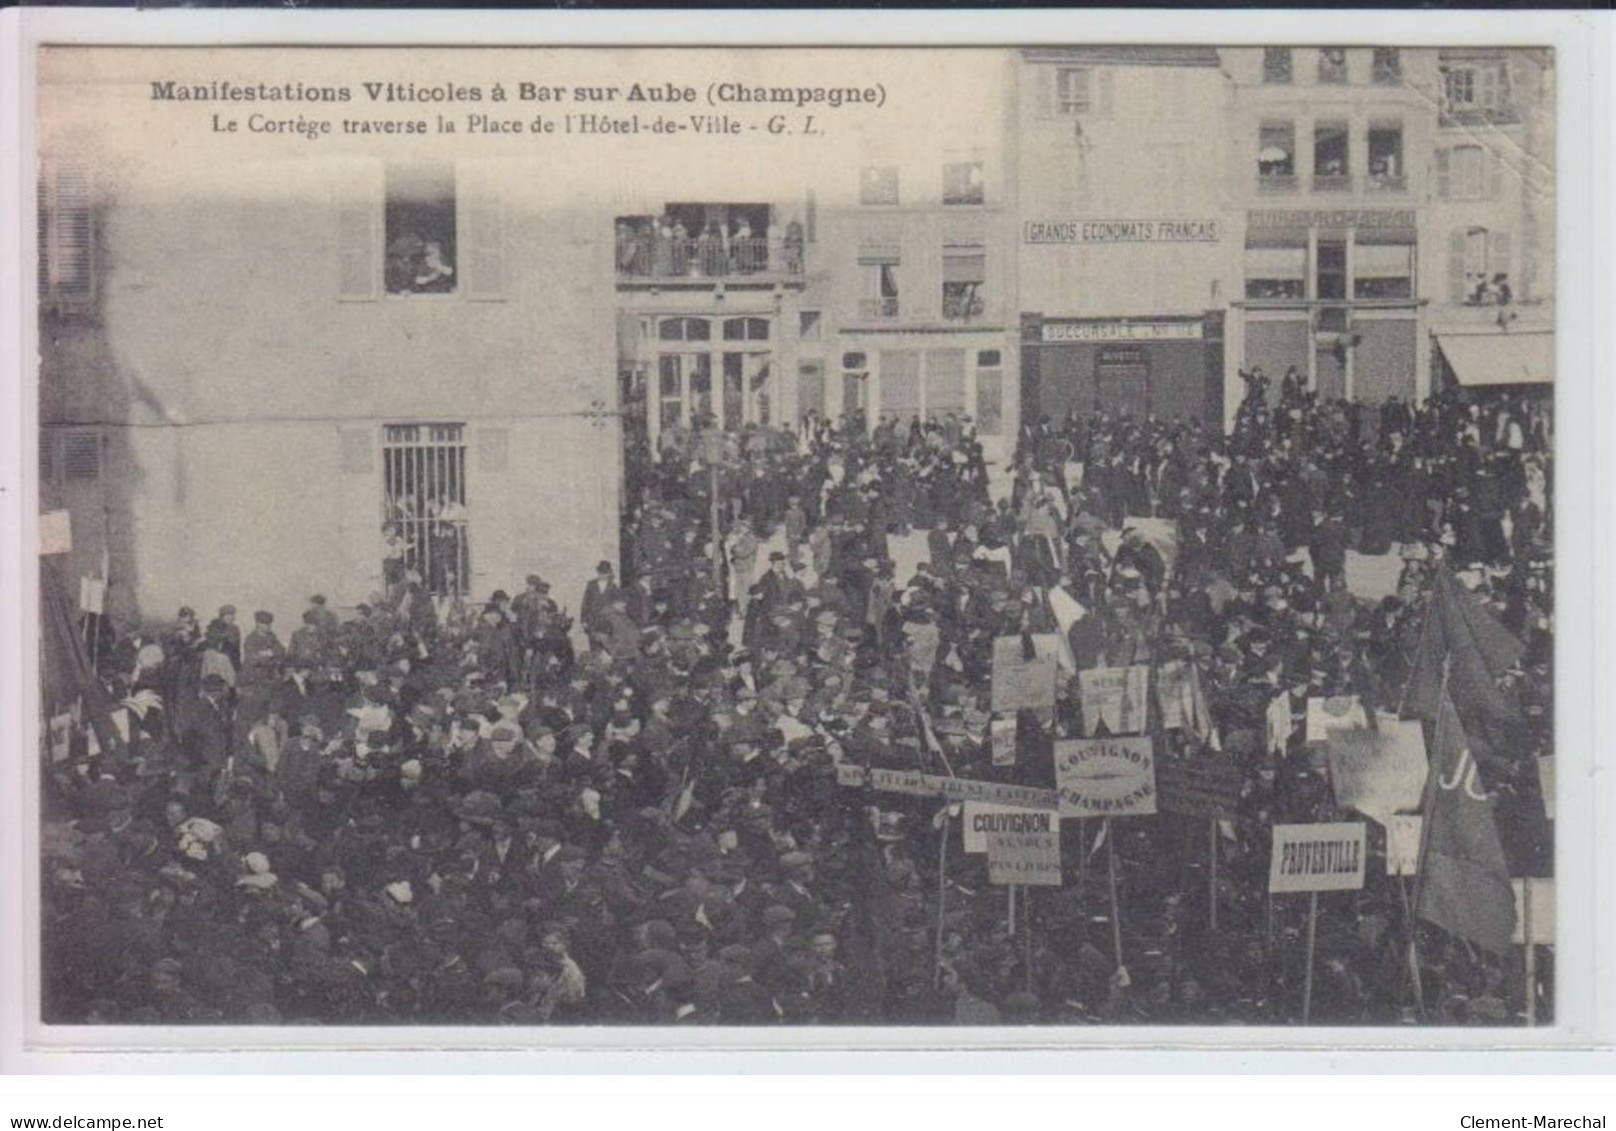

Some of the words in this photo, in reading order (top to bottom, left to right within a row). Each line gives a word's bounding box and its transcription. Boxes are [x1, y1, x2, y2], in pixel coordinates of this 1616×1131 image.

[1029, 222, 1078, 241] GRANDS
[1082, 221, 1154, 241] ECONOMATS
[1049, 323, 1136, 340] SUCCURSALE
[1058, 744, 1151, 773] COUVIGNON
[1059, 782, 1154, 811] CHAMPAGNE
[973, 813, 1050, 833] COUVIGNON
[1281, 840, 1359, 875] PROVERVILLE
